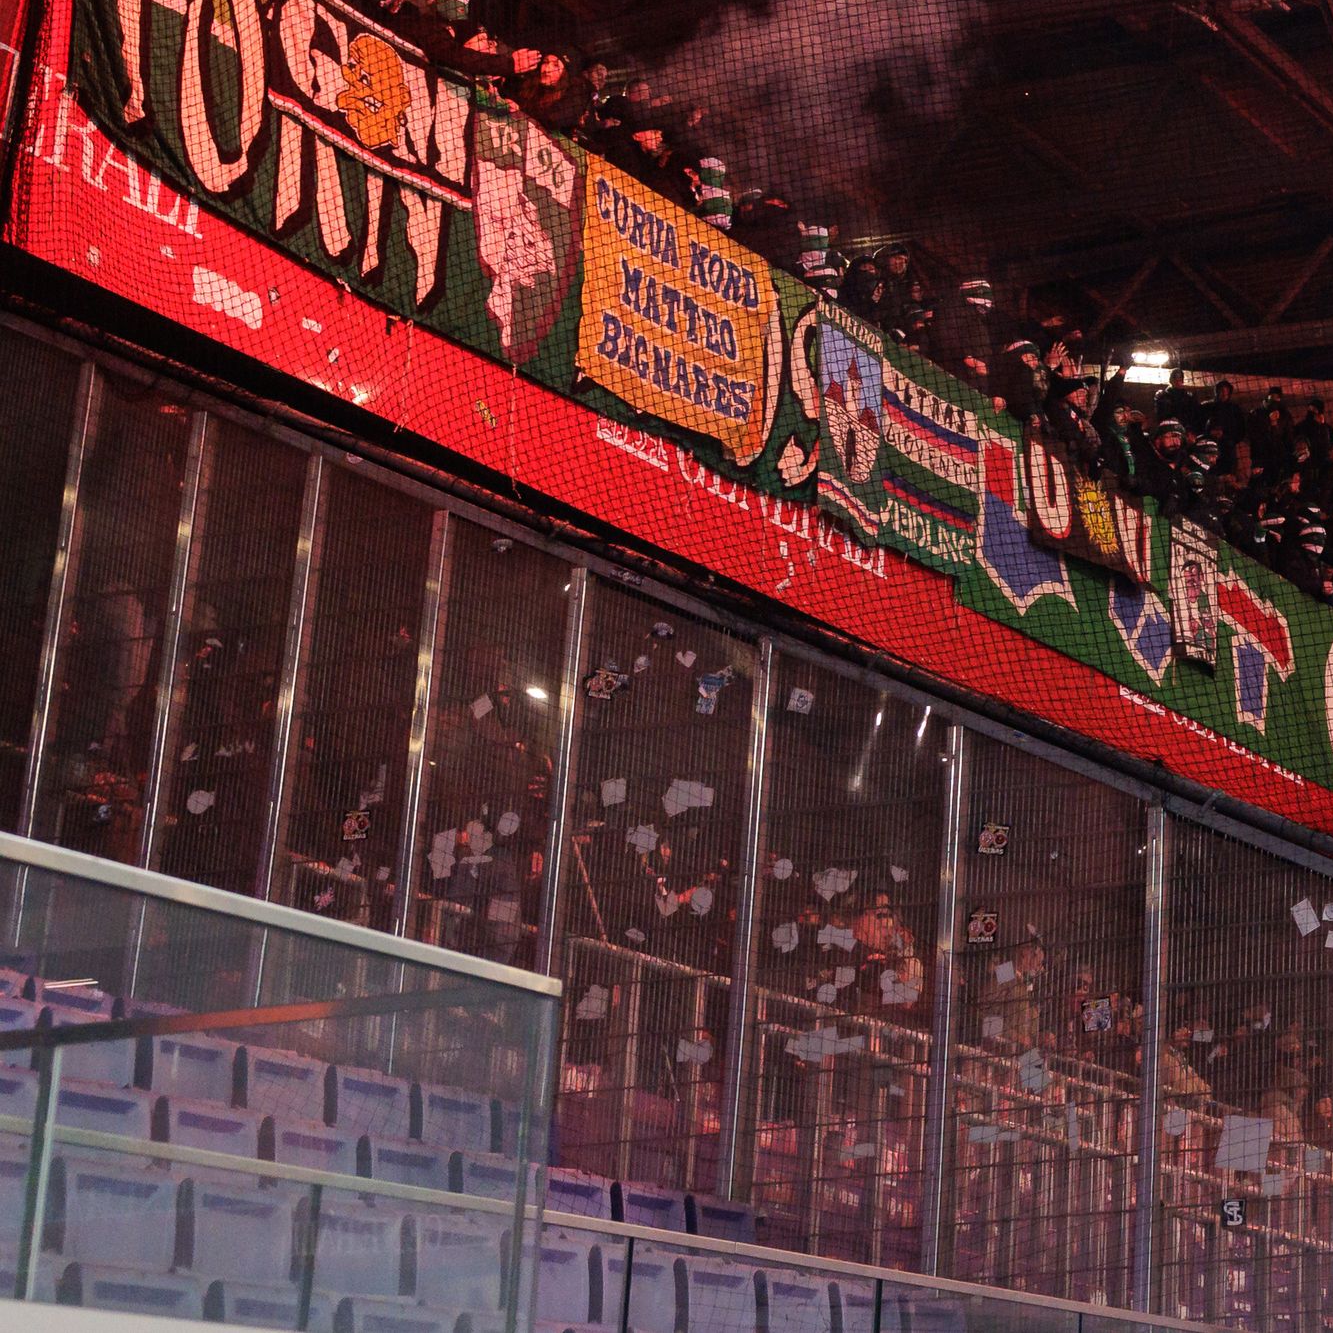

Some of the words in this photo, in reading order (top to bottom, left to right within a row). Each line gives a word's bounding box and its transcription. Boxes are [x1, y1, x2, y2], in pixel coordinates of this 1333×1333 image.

[537, 147, 565, 189] 96
[596, 176, 680, 269] CURVA
[621, 255, 738, 361] MATTEO
